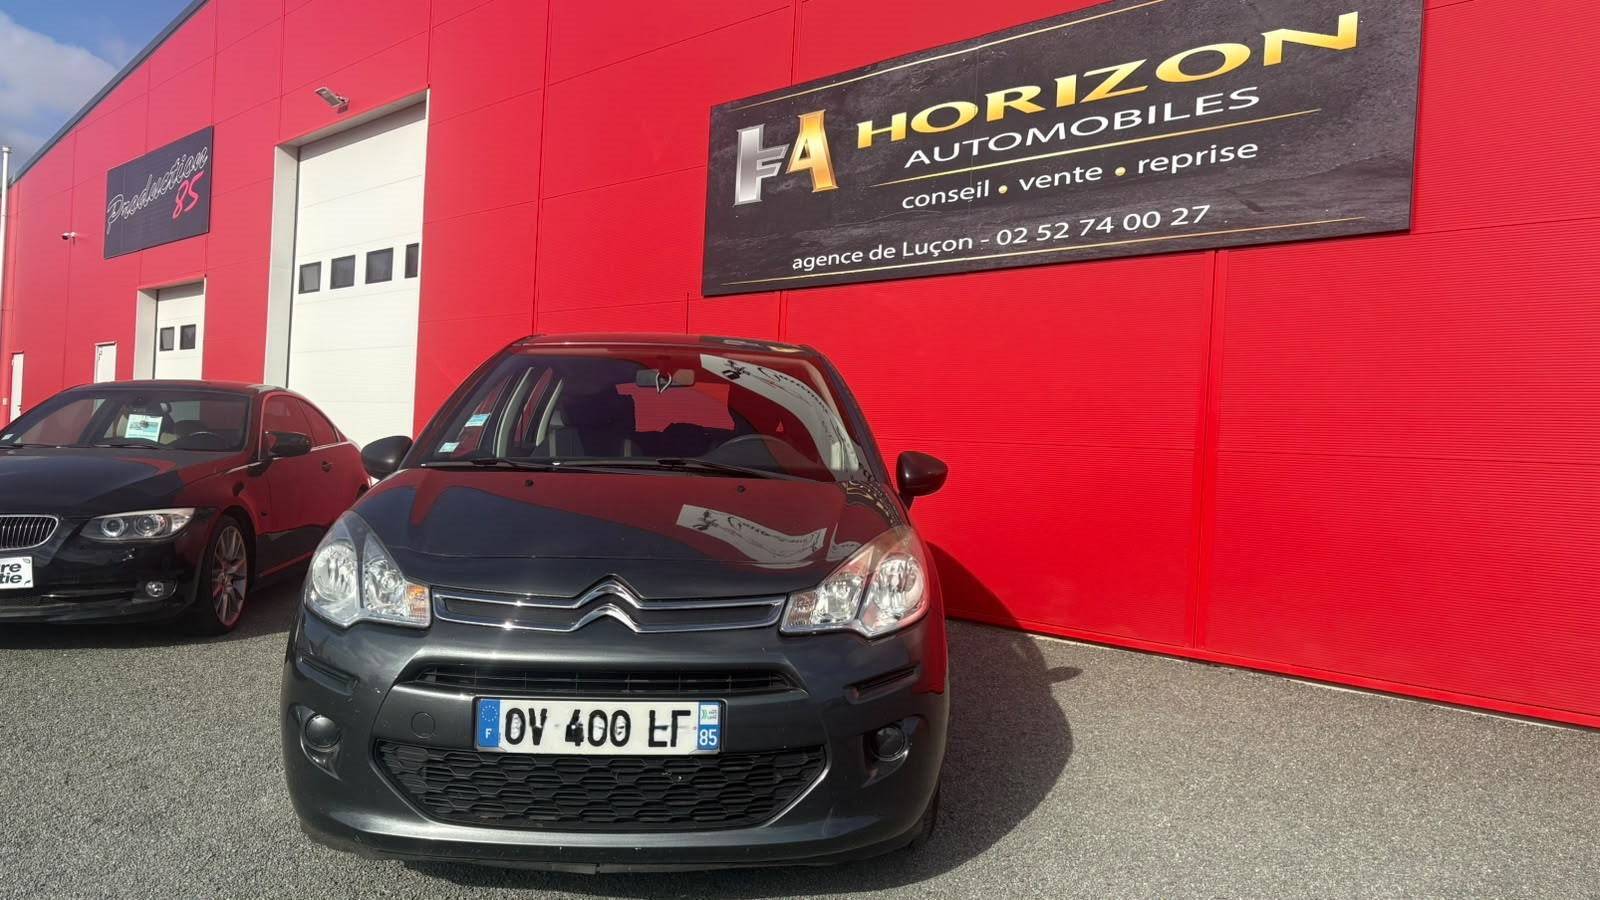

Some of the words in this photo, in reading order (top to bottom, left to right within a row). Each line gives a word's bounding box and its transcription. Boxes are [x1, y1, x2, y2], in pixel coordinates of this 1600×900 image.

[857, 11, 1359, 149] HORIZON
[904, 86, 1260, 169] AUTOMOBILES
[172, 170, 205, 219] 85
[902, 179, 990, 209] conseil
[1019, 166, 1103, 191] vente
[1138, 143, 1258, 174] reprise
[792, 250, 864, 272] agence
[869, 244, 896, 261] de
[902, 237, 973, 257] Luçon
[996, 227, 1028, 246] 02
[1036, 222, 1069, 241] 52
[1079, 216, 1114, 237] 74
[1123, 210, 1161, 231] 00
[1170, 204, 1211, 226] 27
[485, 727, 493, 740] F
[699, 728, 718, 746] 85
